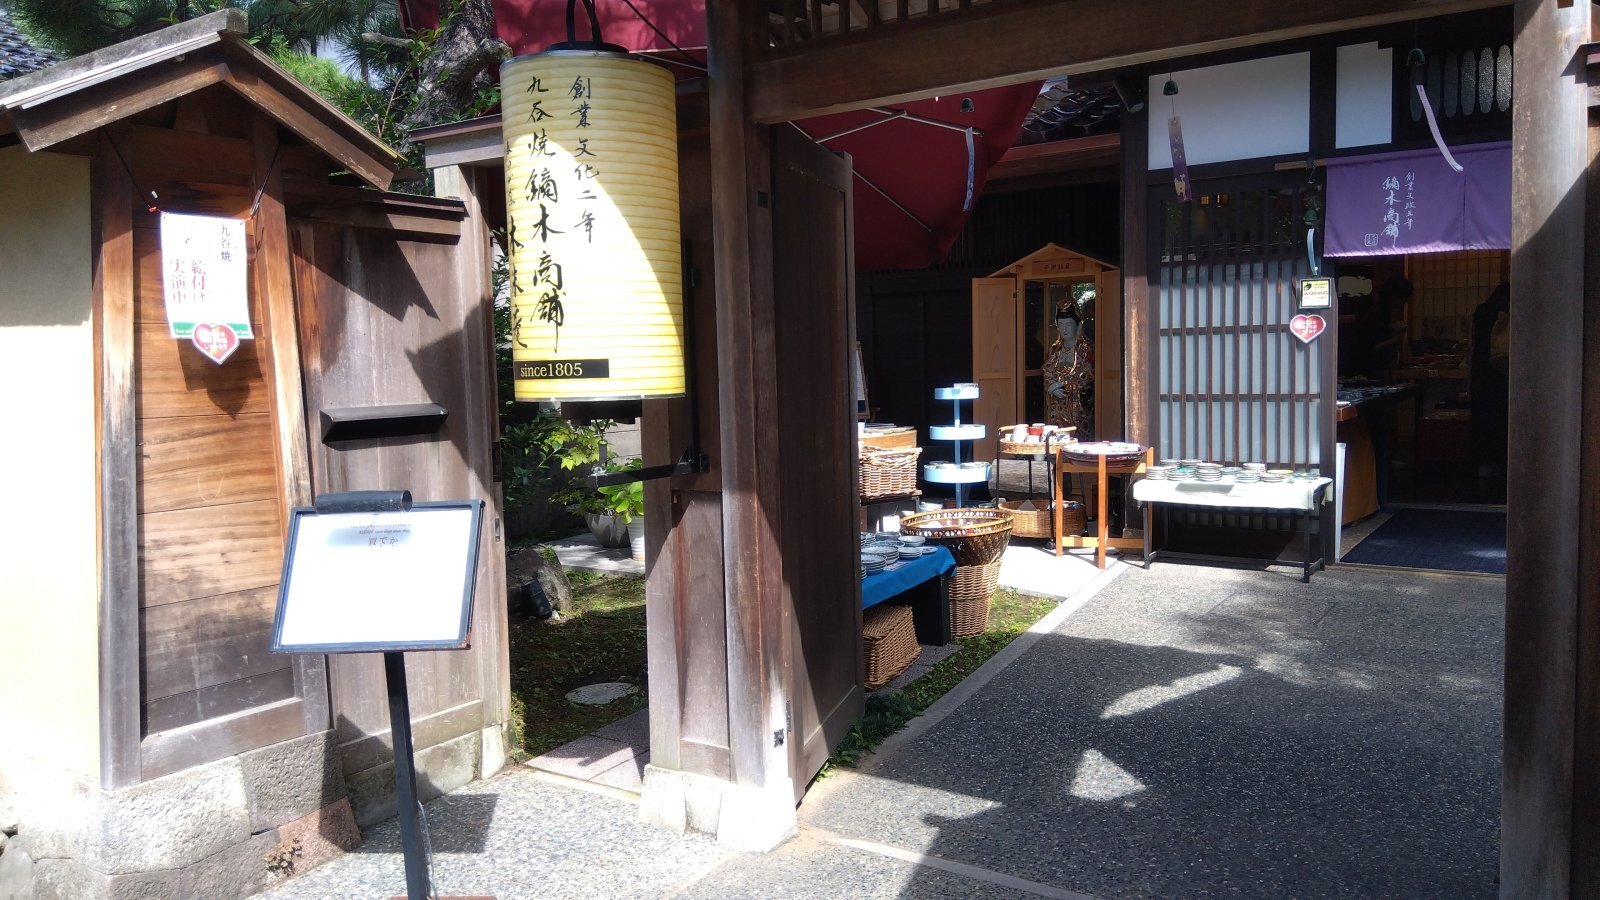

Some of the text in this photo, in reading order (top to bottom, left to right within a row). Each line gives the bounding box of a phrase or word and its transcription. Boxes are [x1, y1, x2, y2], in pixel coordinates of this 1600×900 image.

[569, 75, 600, 244] 創業文化二年
[1381, 175, 1401, 249] 鏑木商舗
[220, 224, 232, 262] 九谷焼
[191, 259, 207, 302] 絵付け
[520, 362, 583, 378] since1805
